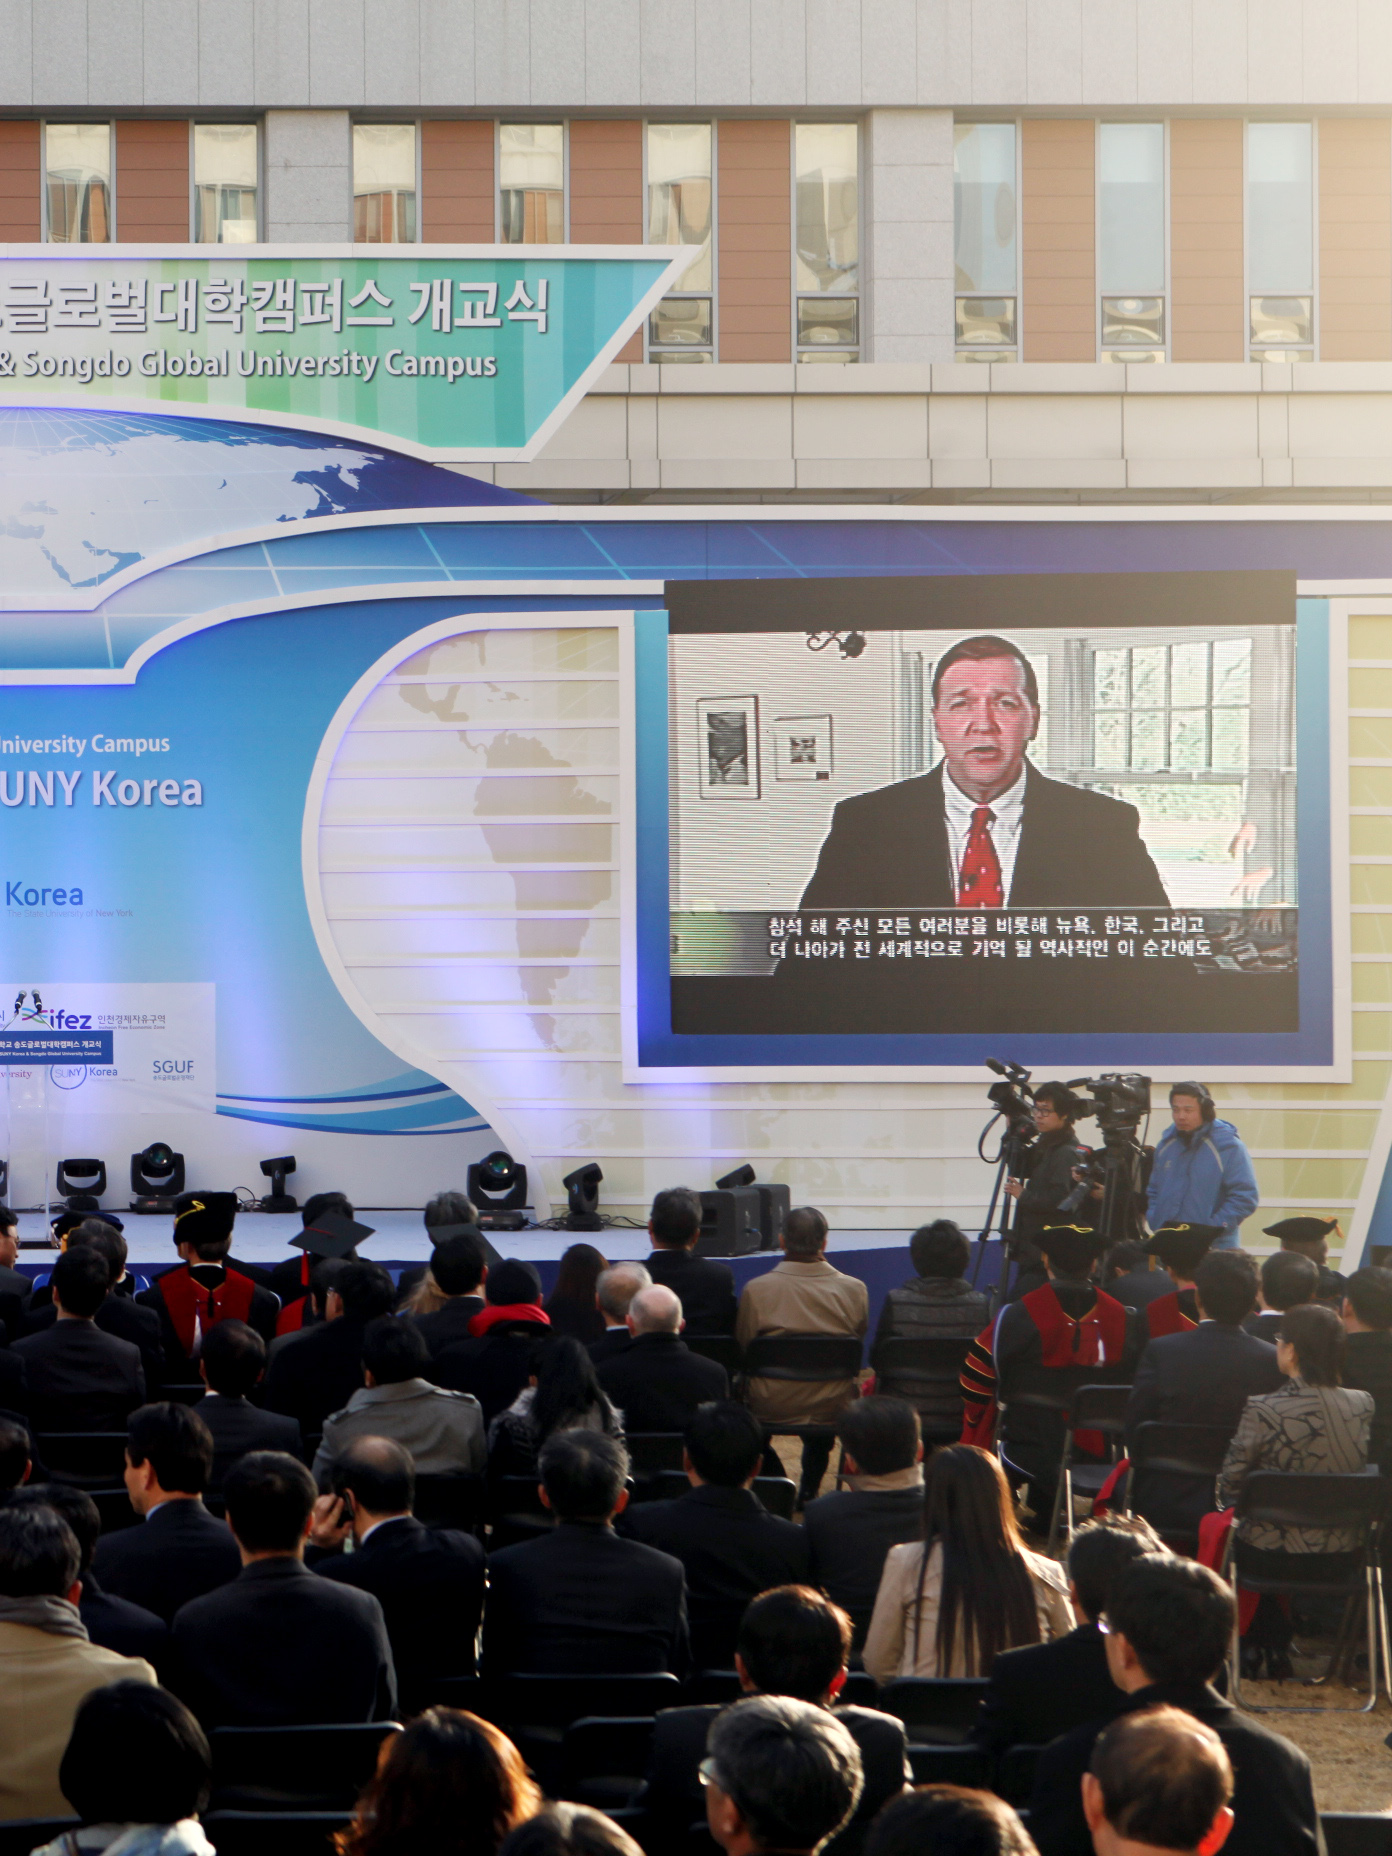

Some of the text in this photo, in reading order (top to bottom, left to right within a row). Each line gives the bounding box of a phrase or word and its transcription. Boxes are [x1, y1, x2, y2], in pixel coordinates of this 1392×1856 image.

[407, 276, 549, 334] 개교식
[22, 347, 131, 383] Songdo
[137, 347, 229, 379] Global
[235, 348, 379, 383] University
[384, 349, 498, 383] Campus
[91, 733, 171, 757] Campus
[92, 769, 204, 808] Korea
[5, 880, 85, 907] Korea
[95, 909, 114, 918] New
[116, 908, 134, 917] York
[768, 916, 802, 937] 참석
[810, 916, 828, 936] 해
[835, 916, 870, 936] 주신
[876, 916, 911, 936] 모든
[919, 915, 988, 936] 여러분을
[996, 915, 1048, 935] 비롯해
[1152, 915, 1205, 934] 그리고
[769, 940, 786, 959] 더
[795, 940, 845, 959] 나아가
[853, 939, 871, 959] 전
[879, 939, 963, 959] 세계적으로
[972, 939, 1006, 958] 기억
[1039, 938, 1109, 958] 역사적인
[1117, 938, 1134, 957] 이
[1142, 938, 1213, 957] 순간에도
[49, 1008, 93, 1030] ifez
[97, 1014, 166, 1025] 인천경제자유구역
[54, 1066, 118, 1079] SUNY Korea
[152, 1060, 195, 1074] SGUF
